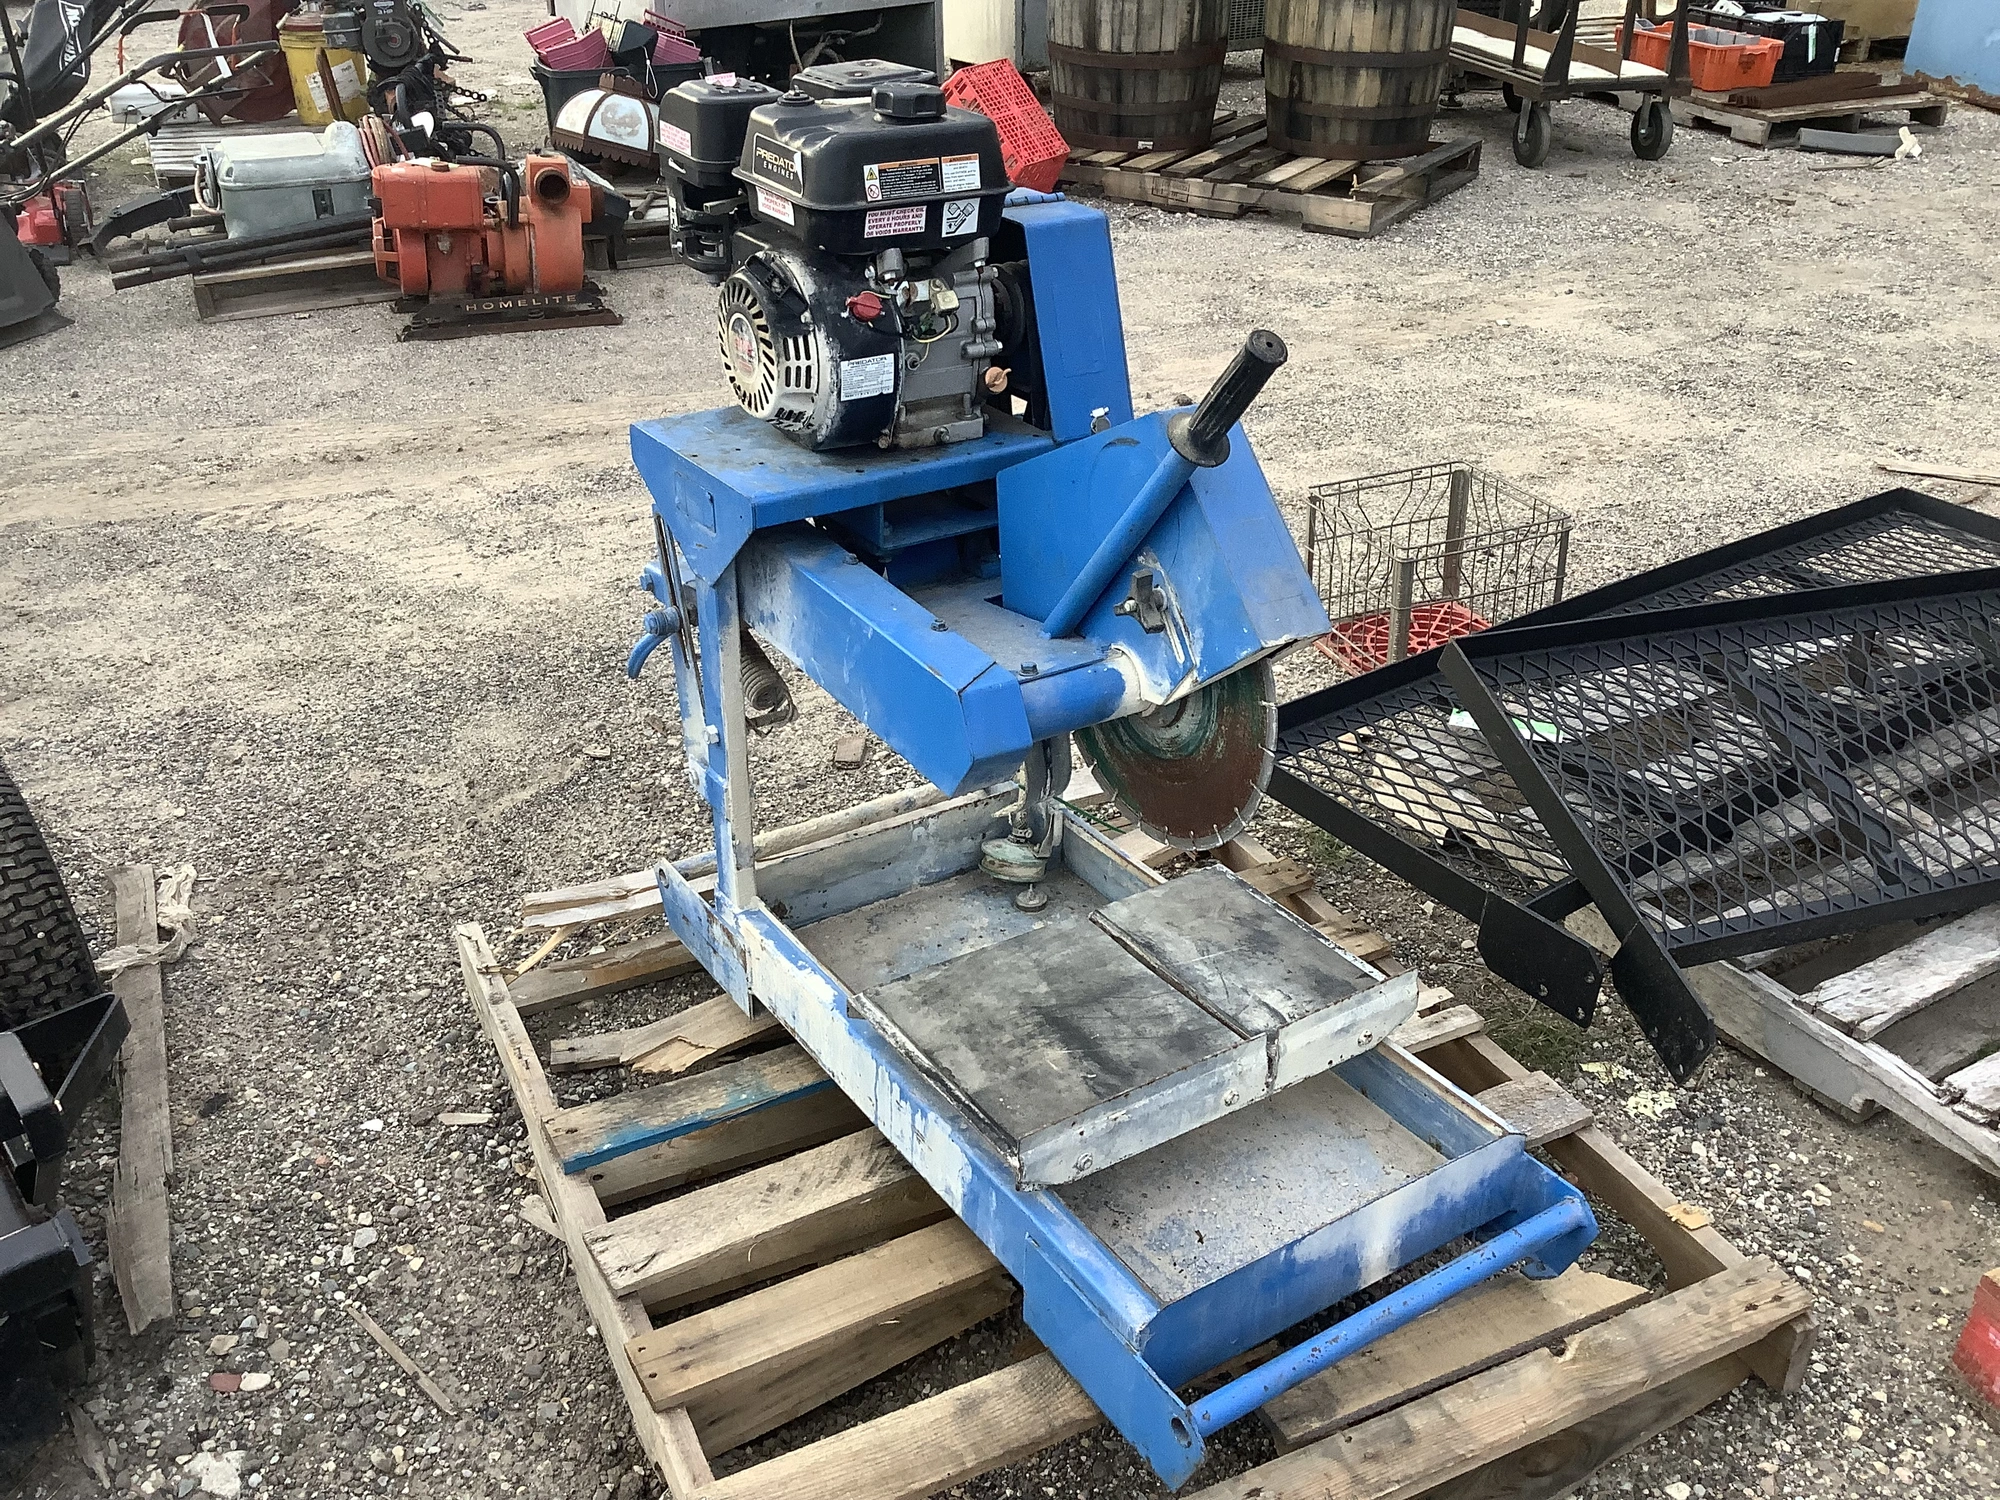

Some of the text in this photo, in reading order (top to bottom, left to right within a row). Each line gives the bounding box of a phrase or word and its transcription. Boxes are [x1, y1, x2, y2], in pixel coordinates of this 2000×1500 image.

[756, 147, 797, 172] PREDATO
[763, 161, 794, 180] ENGINES
[466, 295, 576, 311] HOMELITE
